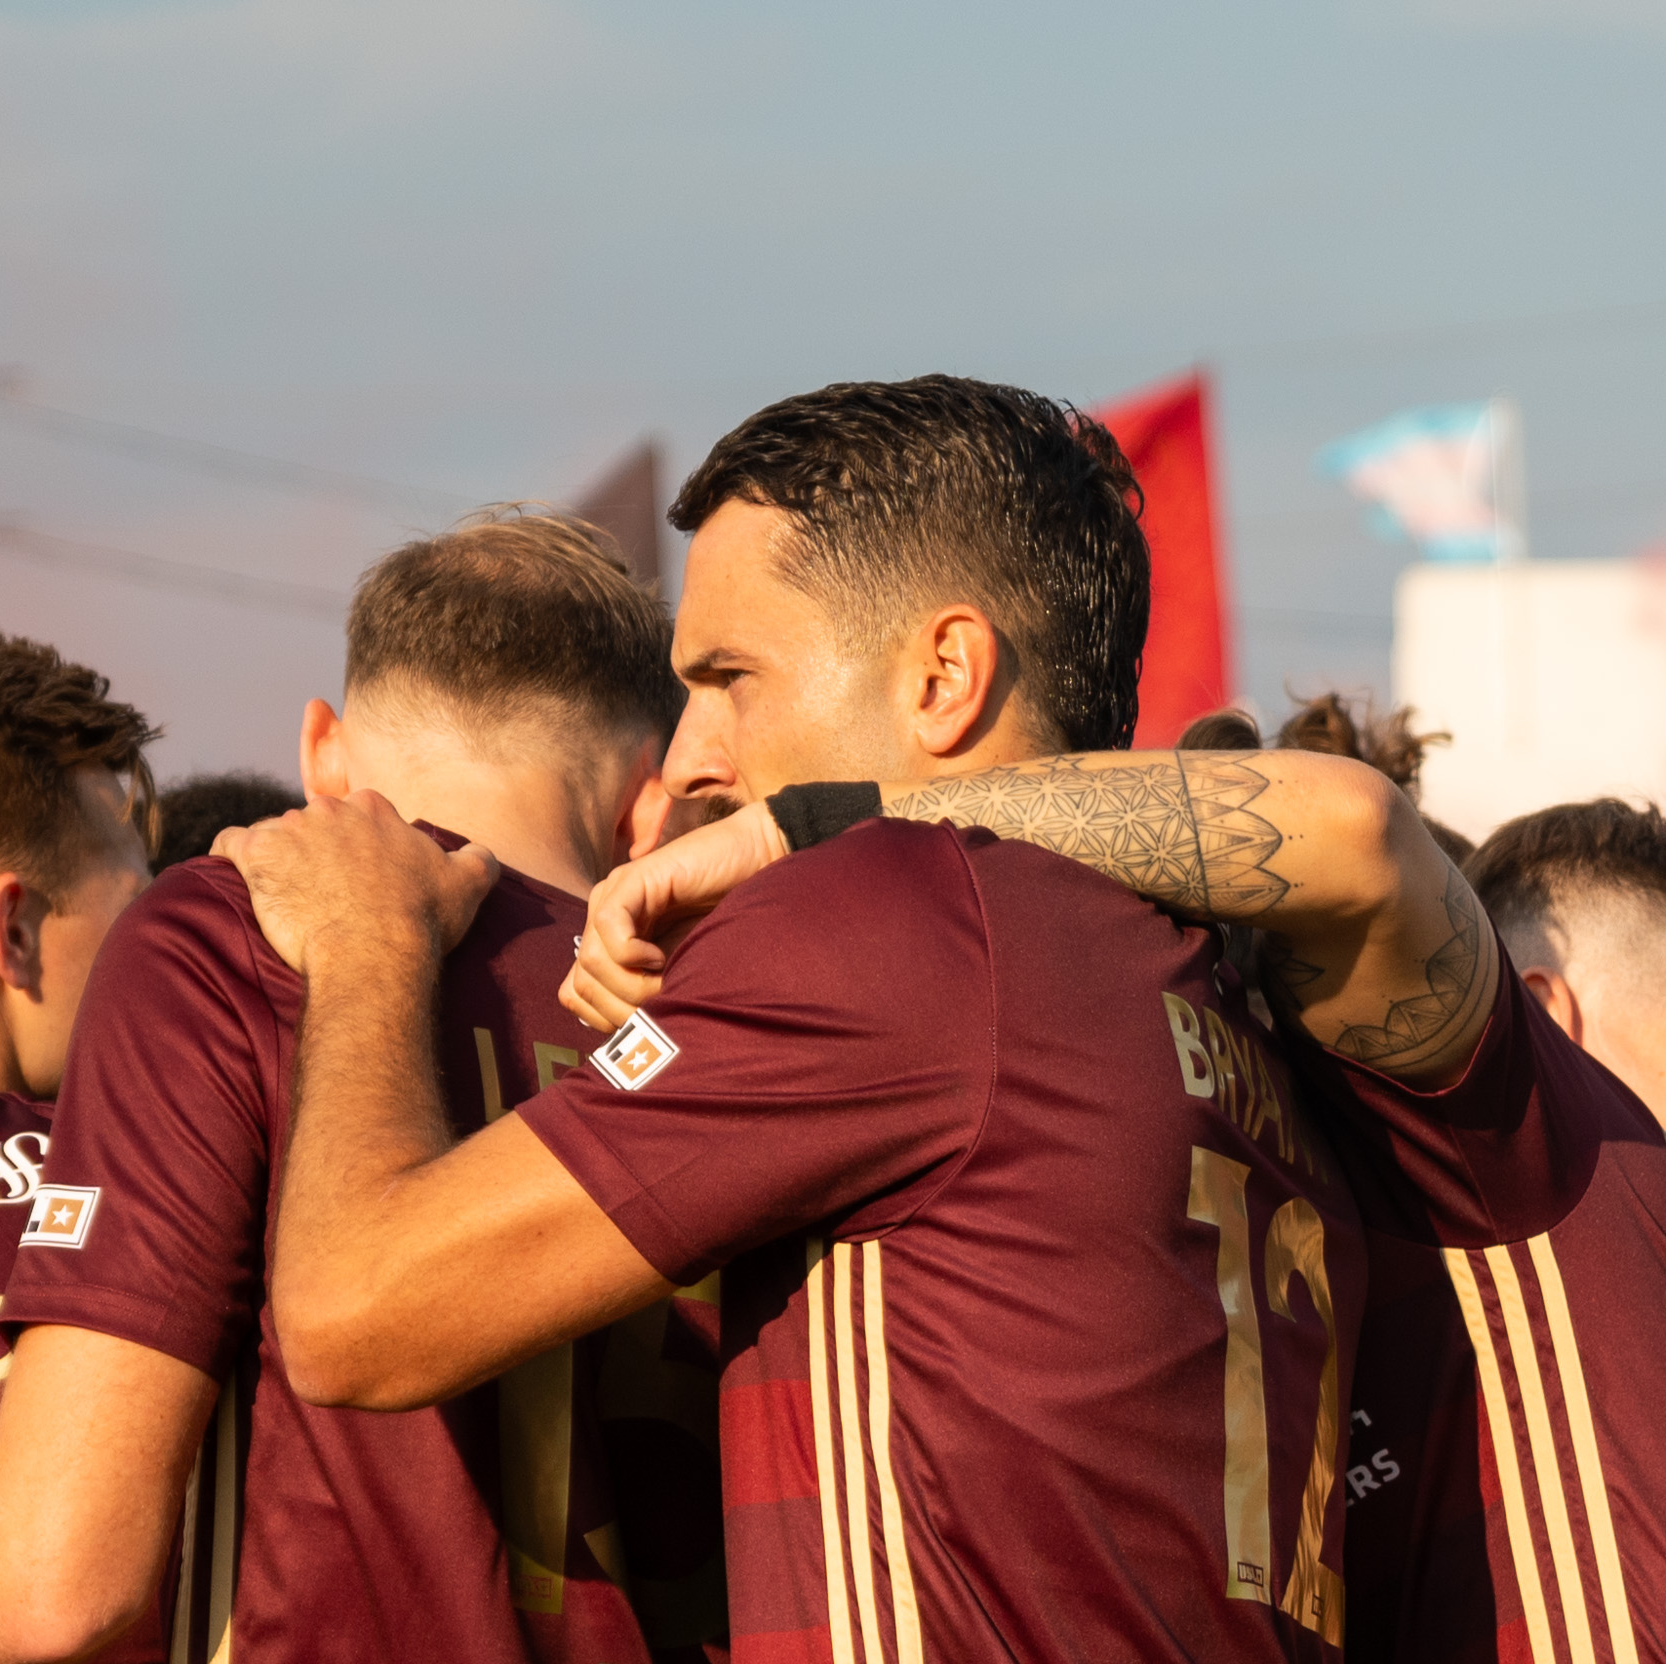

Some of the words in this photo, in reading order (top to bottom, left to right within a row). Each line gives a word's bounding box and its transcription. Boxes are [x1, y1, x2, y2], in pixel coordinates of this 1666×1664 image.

[1162, 991, 1329, 1185] BRYAN
[1186, 1145, 1344, 1648] 12
[1344, 1447, 1401, 1507] RS
